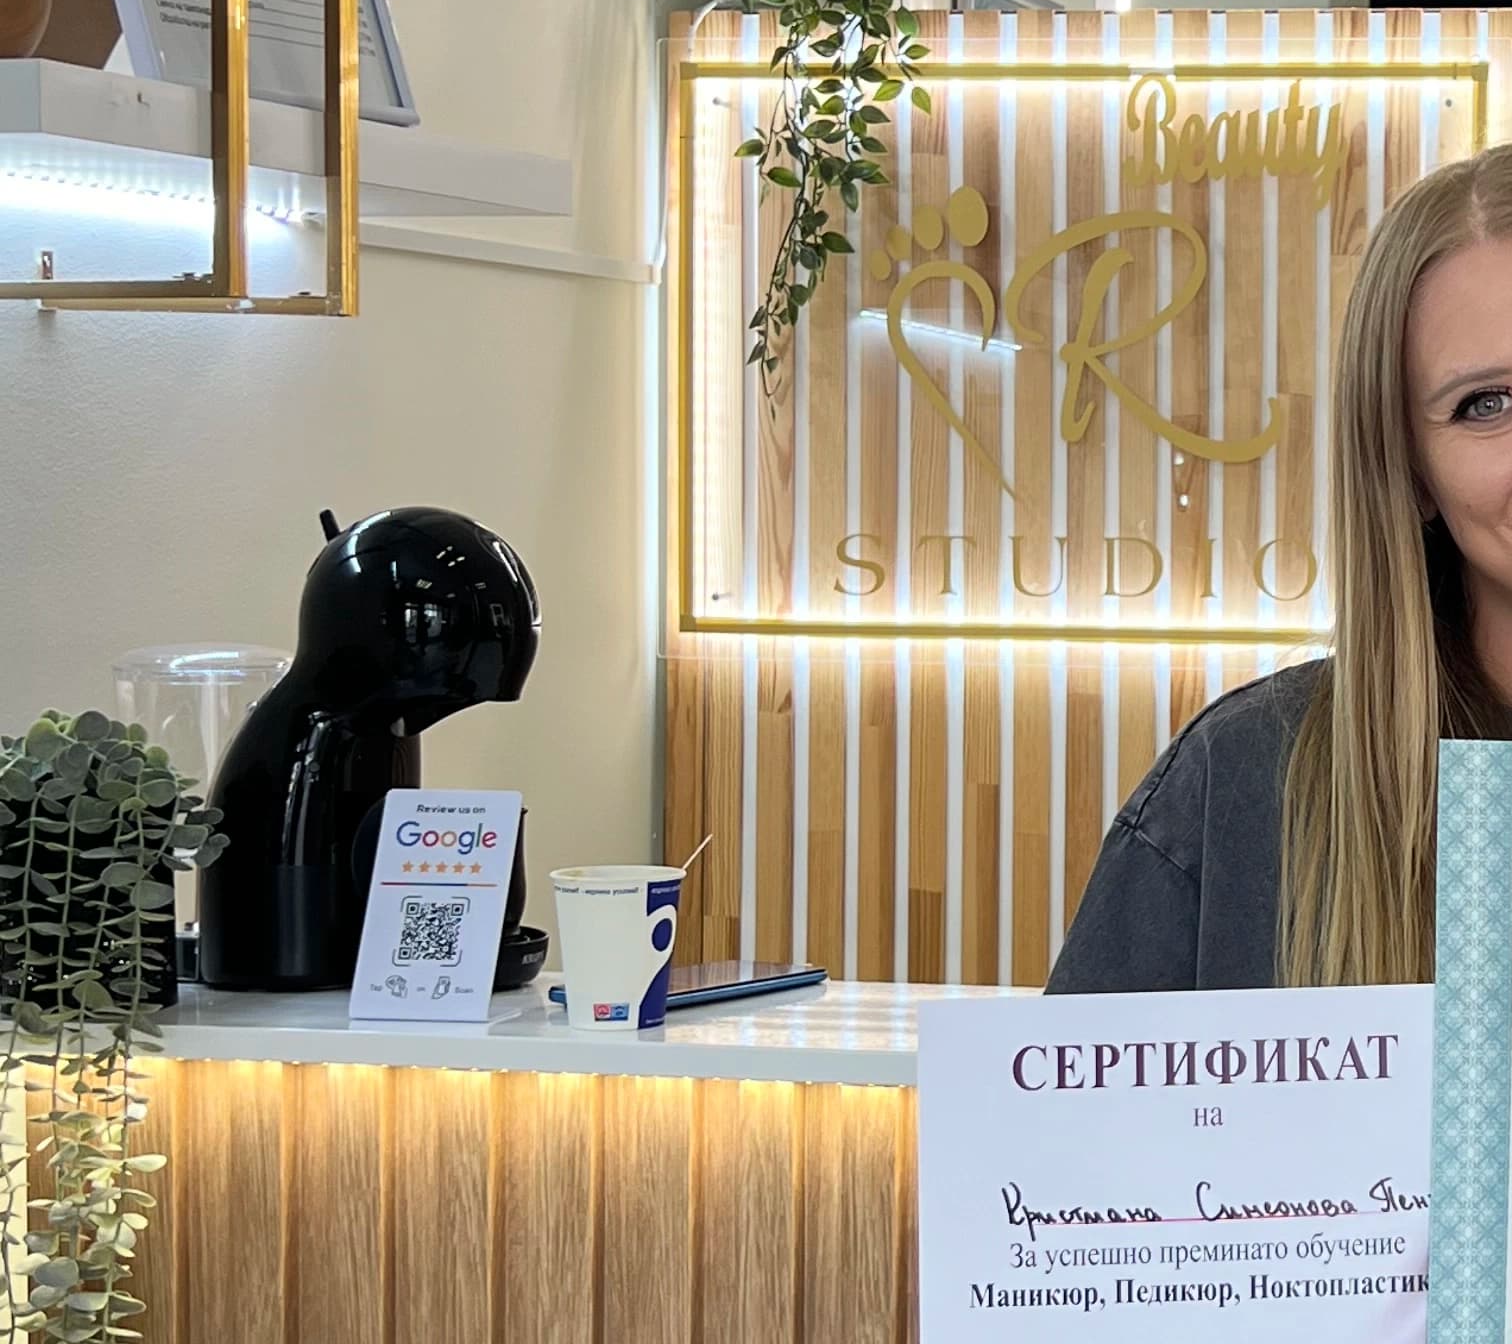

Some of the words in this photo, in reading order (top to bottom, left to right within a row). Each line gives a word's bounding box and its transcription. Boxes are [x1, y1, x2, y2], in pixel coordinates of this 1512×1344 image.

[1122, 72, 1347, 212] Beauty
[832, 531, 1319, 602] STUDIO
[416, 803, 456, 814] Review
[458, 805, 470, 814] us
[472, 806, 486, 814] on
[396, 820, 498, 855] Google
[1012, 1033, 1399, 1092] СЕРТИФИКАТ
[1193, 1104, 1224, 1128] на
[1001, 1181, 1163, 1242] Кристиана
[1368, 1176, 1431, 1214] Пен
[1010, 1242, 1037, 1269] За
[1045, 1244, 1152, 1274] успешно
[1159, 1240, 1289, 1270] преминато
[1296, 1232, 1407, 1264] обучение
[969, 1281, 1106, 1312] Маникюр,
[1115, 1277, 1241, 1307] Педикюр,
